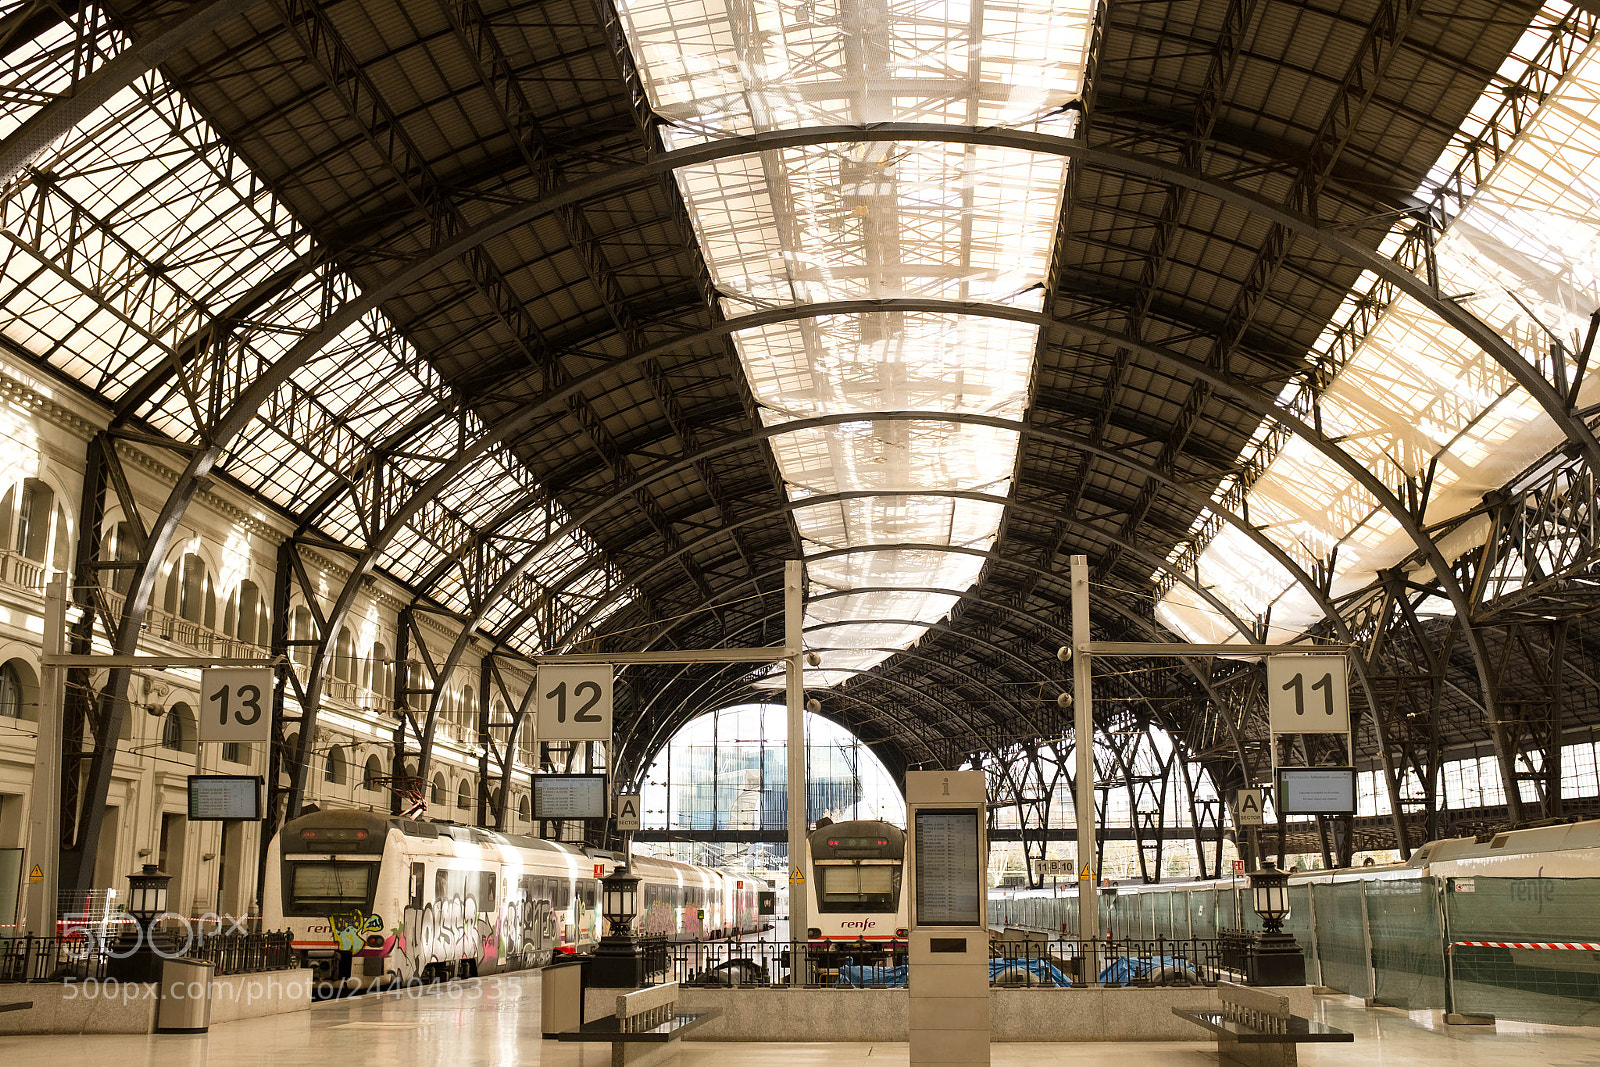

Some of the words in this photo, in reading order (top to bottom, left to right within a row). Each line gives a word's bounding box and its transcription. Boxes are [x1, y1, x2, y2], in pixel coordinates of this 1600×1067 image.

[545, 680, 603, 724] 12
[1281, 672, 1334, 716] 11
[210, 684, 262, 725] 13
[620, 800, 637, 818] A
[1242, 794, 1259, 813] A
[1037, 863, 1047, 872] 11
[1051, 861, 1058, 870] B
[1062, 862, 1073, 872] 10
[1510, 866, 1555, 914] renfe
[307, 925, 332, 933] ren
[841, 918, 876, 932] renfe
